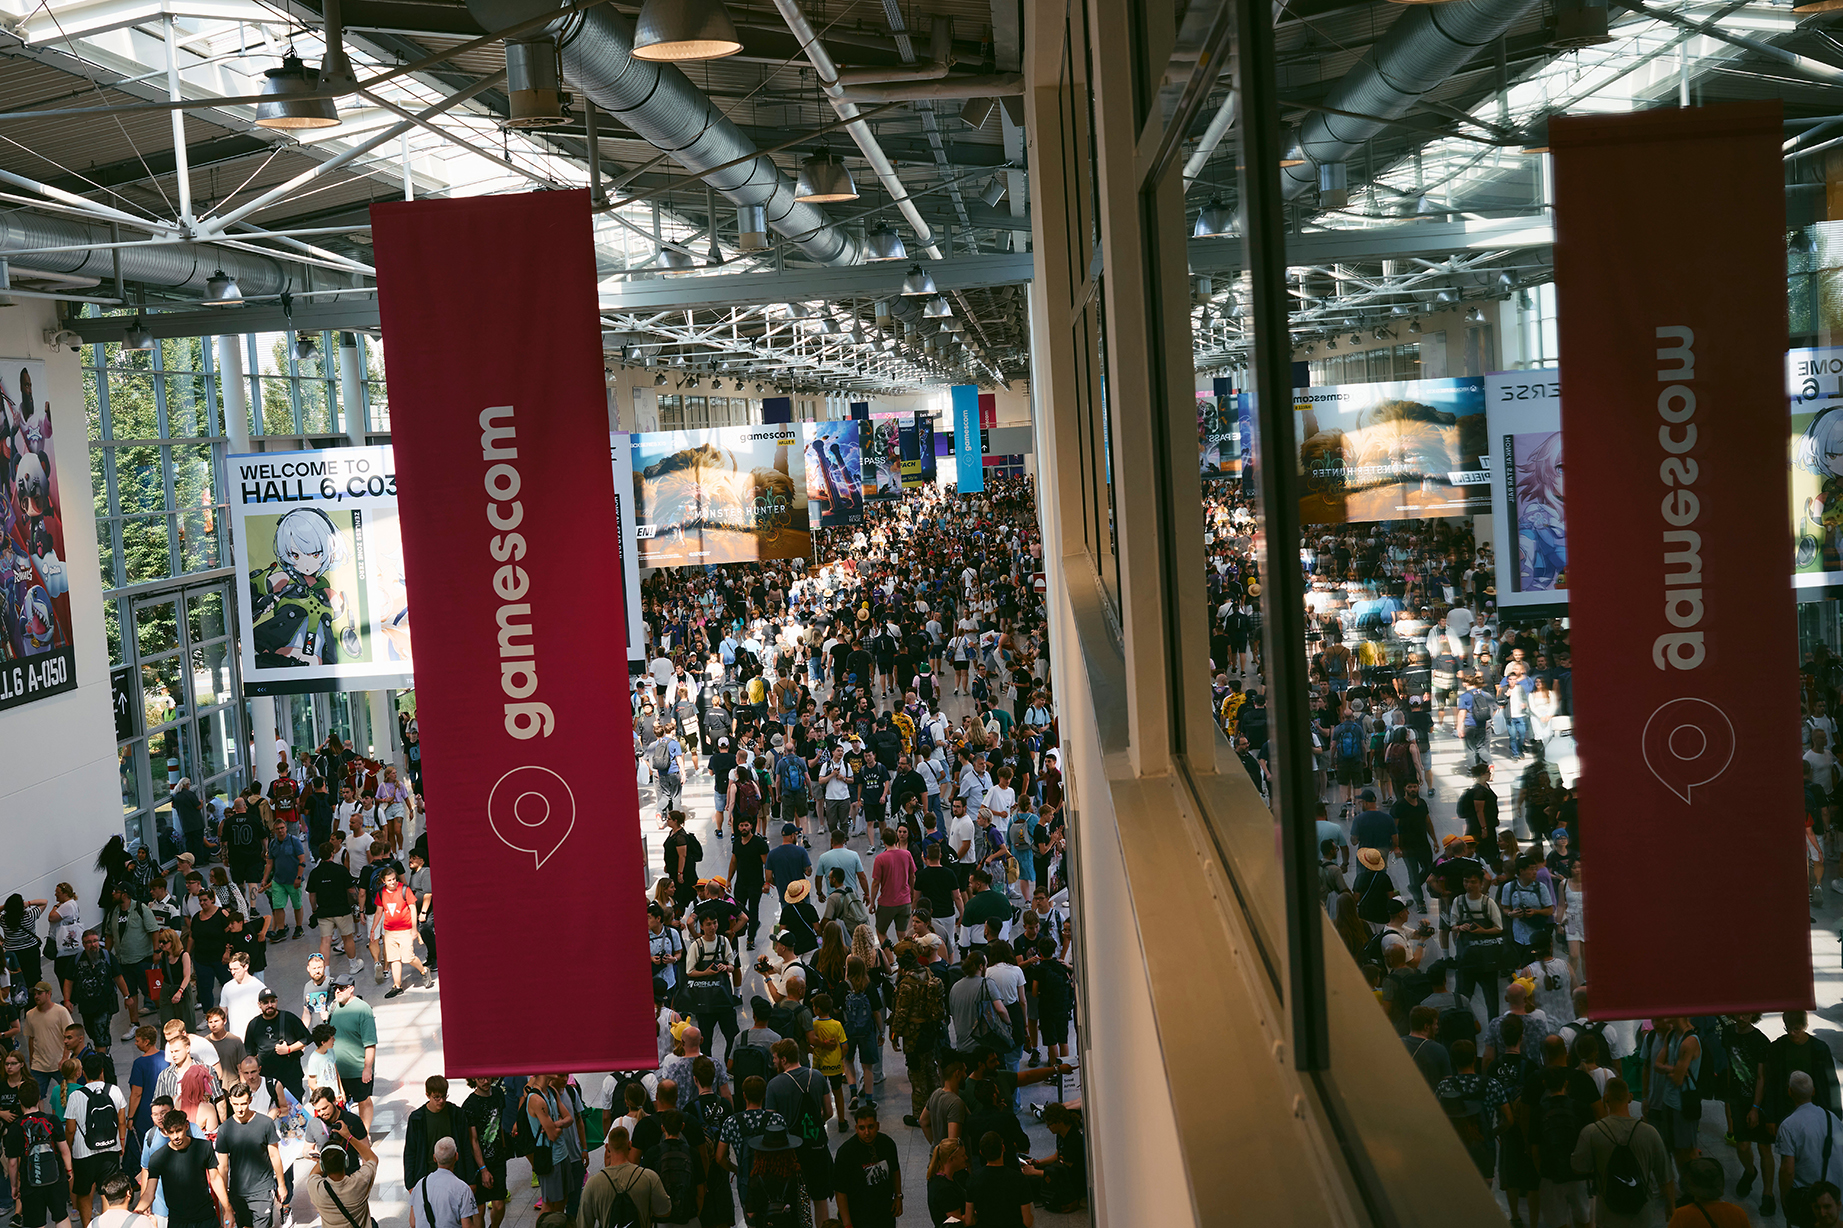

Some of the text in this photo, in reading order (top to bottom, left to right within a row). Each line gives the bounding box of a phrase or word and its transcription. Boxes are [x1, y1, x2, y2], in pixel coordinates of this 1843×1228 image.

[740, 430, 796, 443] gamescom
[963, 409, 972, 452] gamescom
[239, 459, 370, 480] WELCOME TO
[864, 456, 886, 465] PASS
[241, 479, 314, 504] HALL
[694, 504, 786, 519] MONSTER HUNTER
[637, 527, 654, 537] EN!
[354, 511, 366, 580] ZENLESS ZONE ZERO
[479, 406, 555, 740] gamescom
[28, 655, 68, 693] A-050
[232, 824, 253, 845] 10
